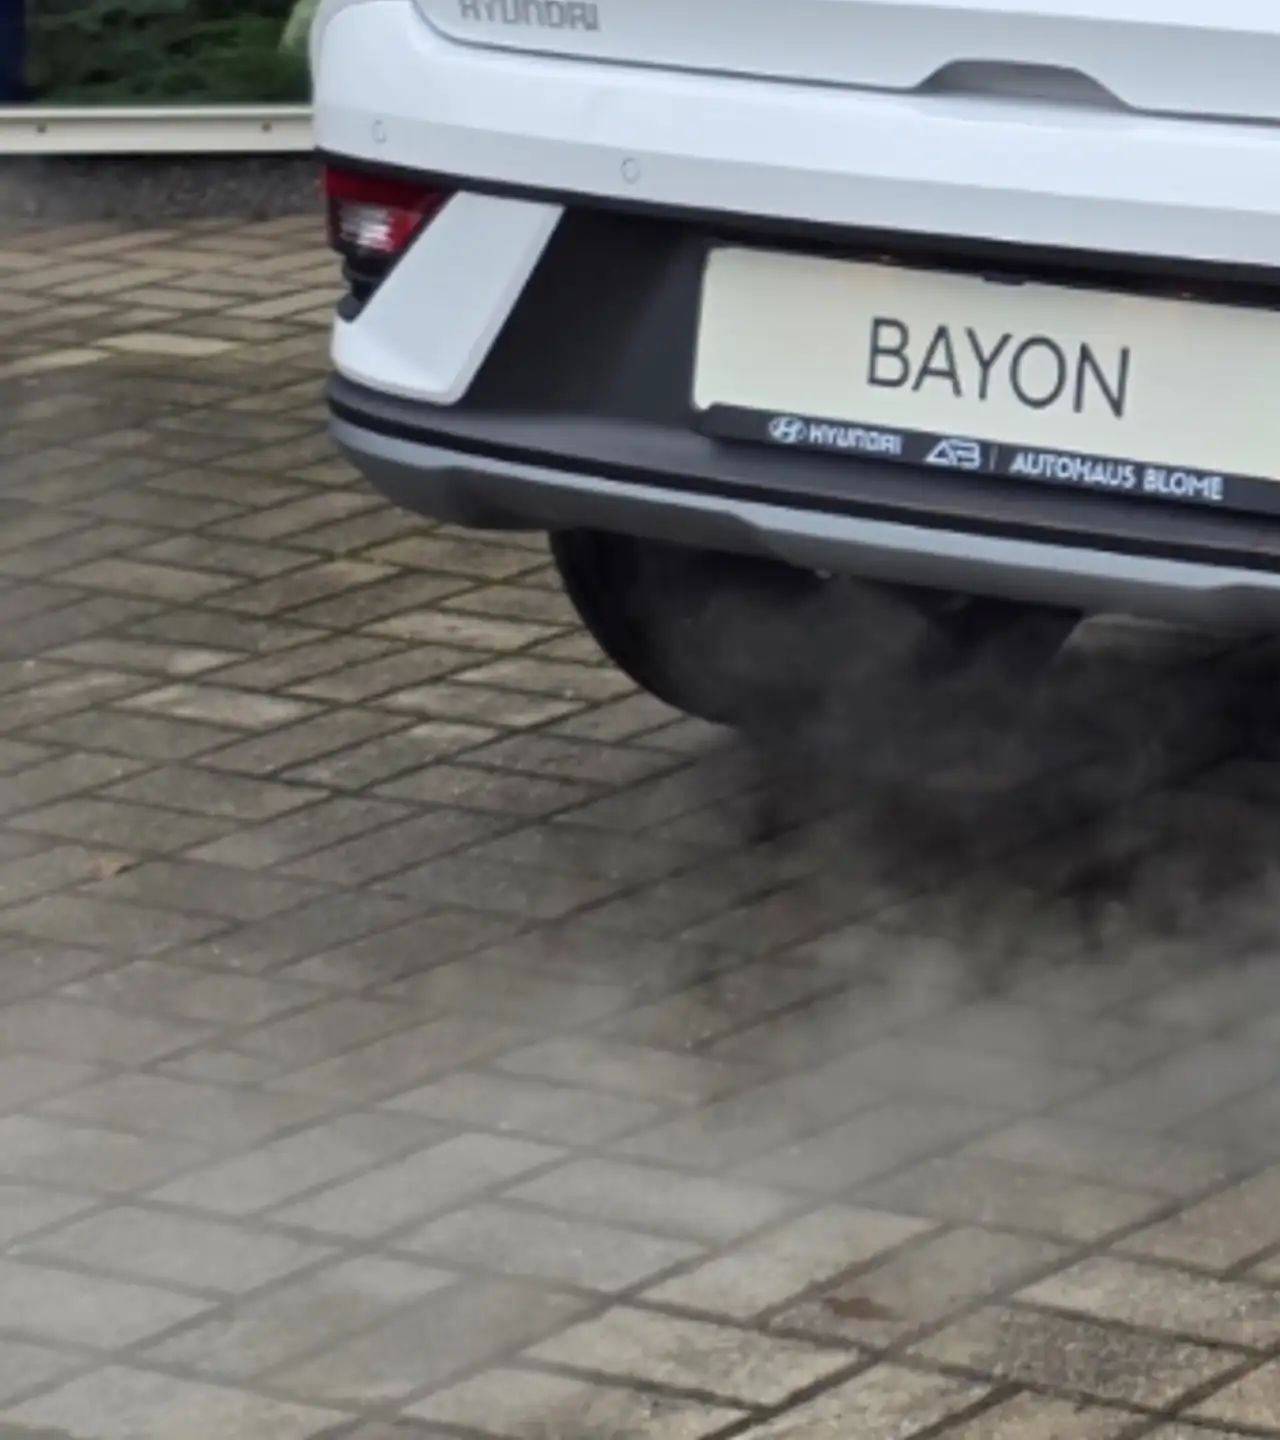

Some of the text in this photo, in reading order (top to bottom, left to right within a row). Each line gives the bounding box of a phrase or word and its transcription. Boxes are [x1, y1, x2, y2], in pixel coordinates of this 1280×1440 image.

[866, 316, 1132, 418] BAYON
[808, 422, 903, 456] HYUNDAI
[1009, 452, 1136, 489] AUTOHAUS
[1143, 467, 1224, 501] BLOME
